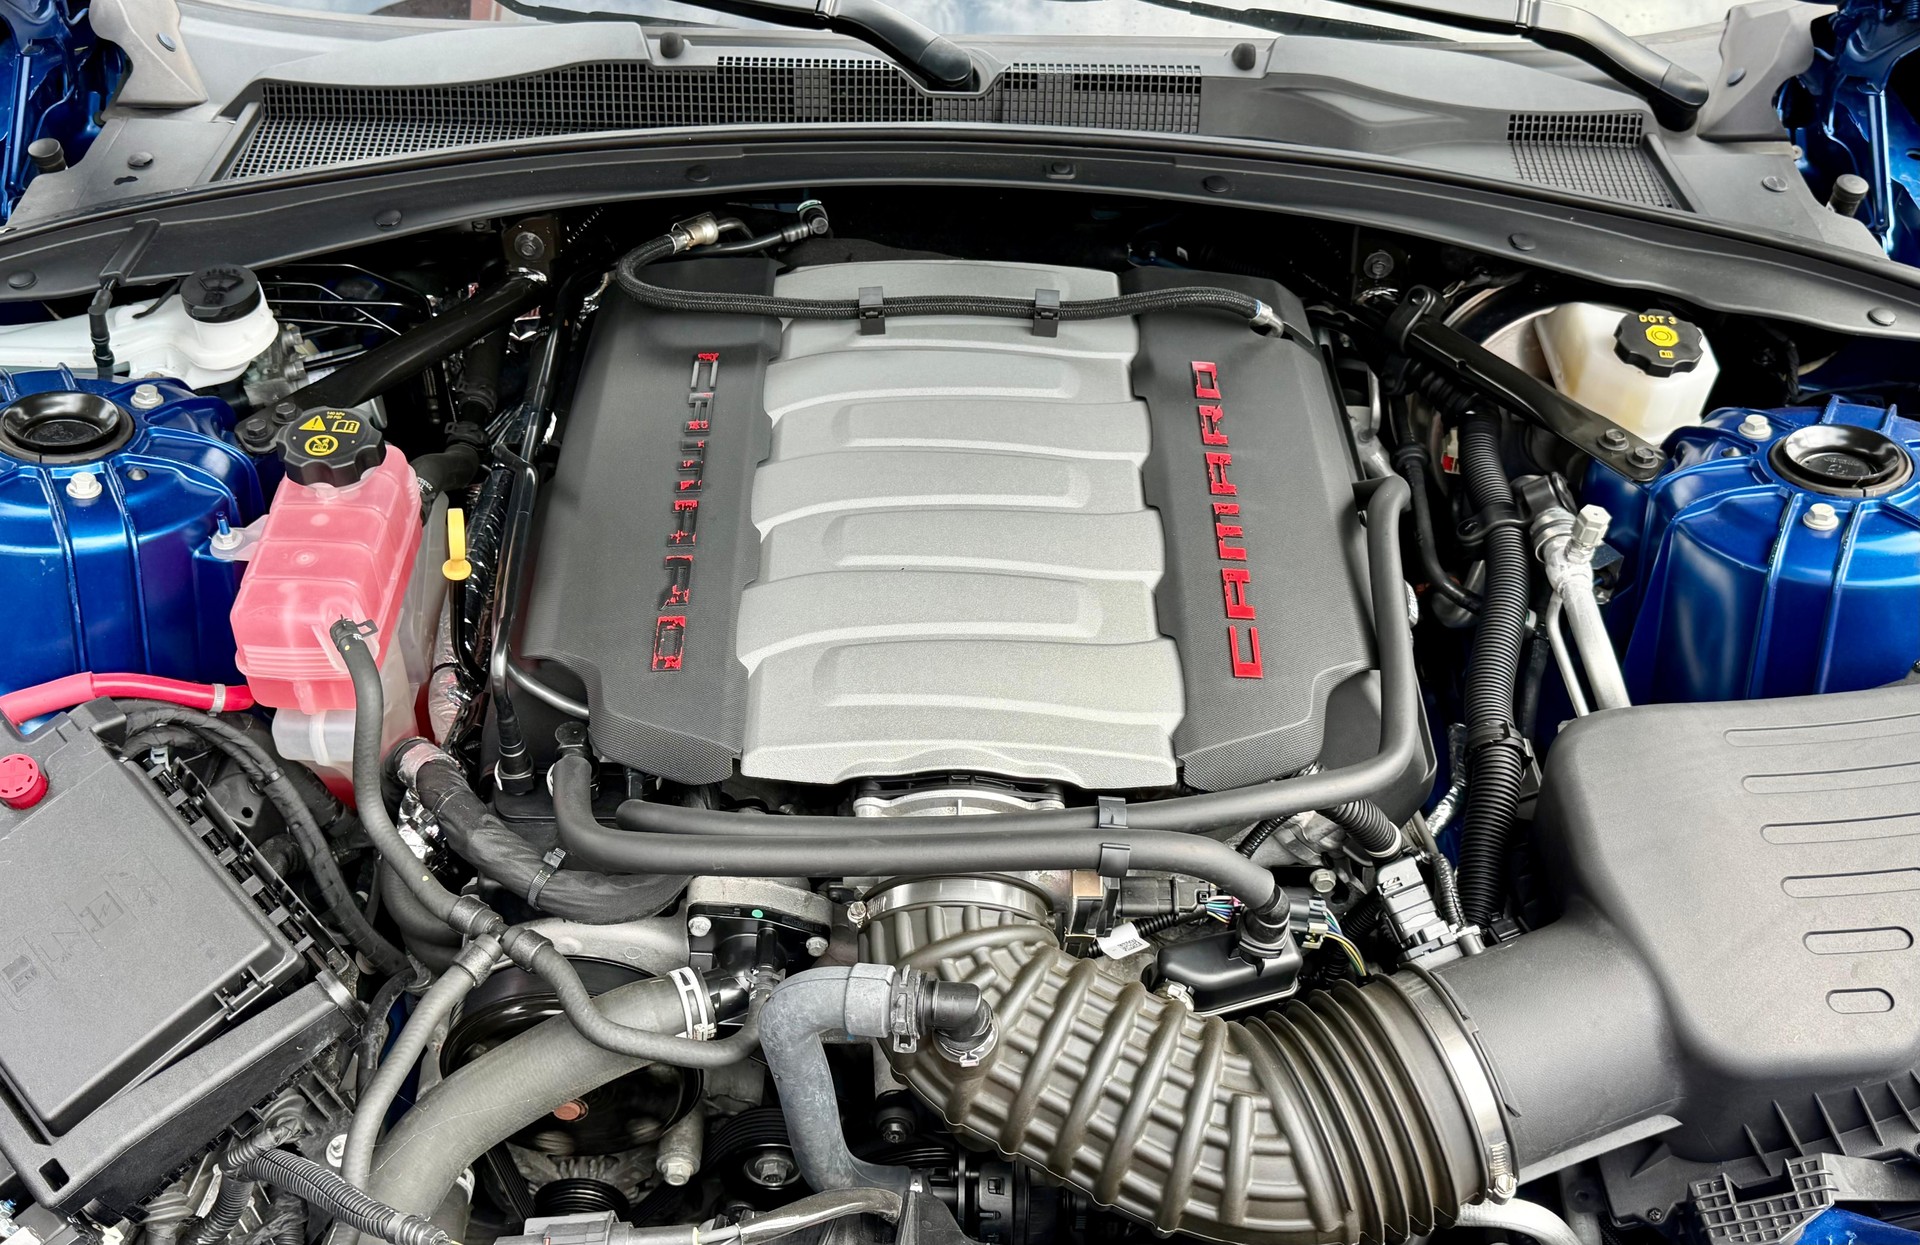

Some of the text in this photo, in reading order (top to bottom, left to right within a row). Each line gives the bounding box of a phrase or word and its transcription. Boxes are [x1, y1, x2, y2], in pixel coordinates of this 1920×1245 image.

[1639, 314, 1677, 324] DOT 3
[651, 352, 719, 671] CAMARO
[1191, 361, 1264, 678] CAMARO
